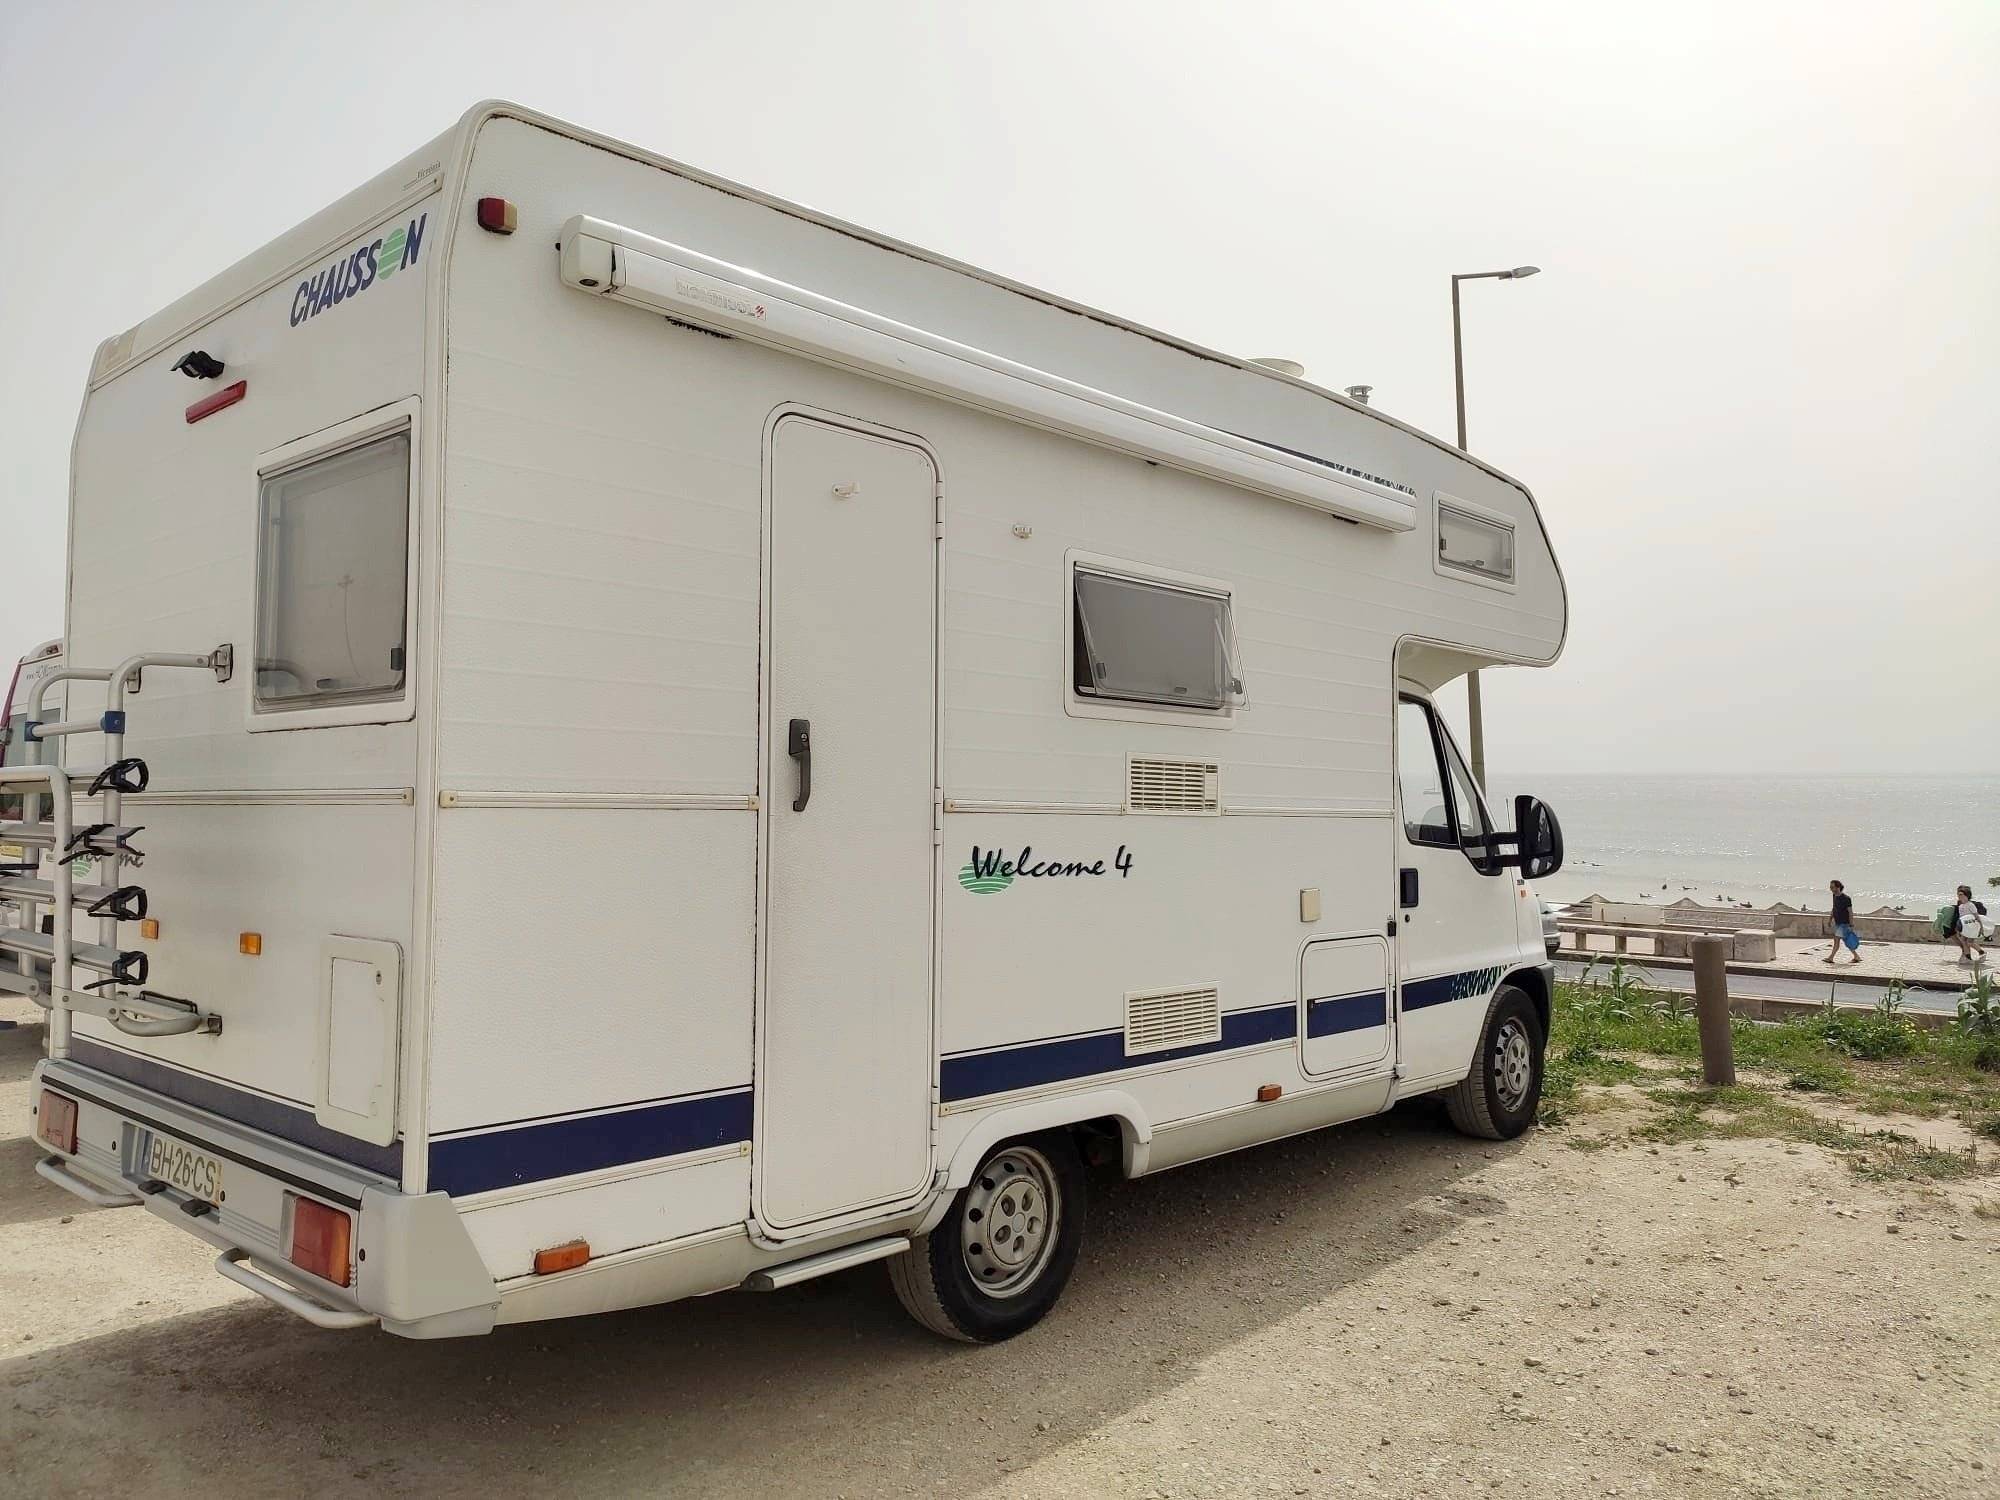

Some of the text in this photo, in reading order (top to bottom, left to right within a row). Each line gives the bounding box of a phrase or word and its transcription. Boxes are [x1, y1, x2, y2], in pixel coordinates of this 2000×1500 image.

[290, 213, 427, 327] CHAUSSON
[972, 845, 1133, 879] Welcome 4
